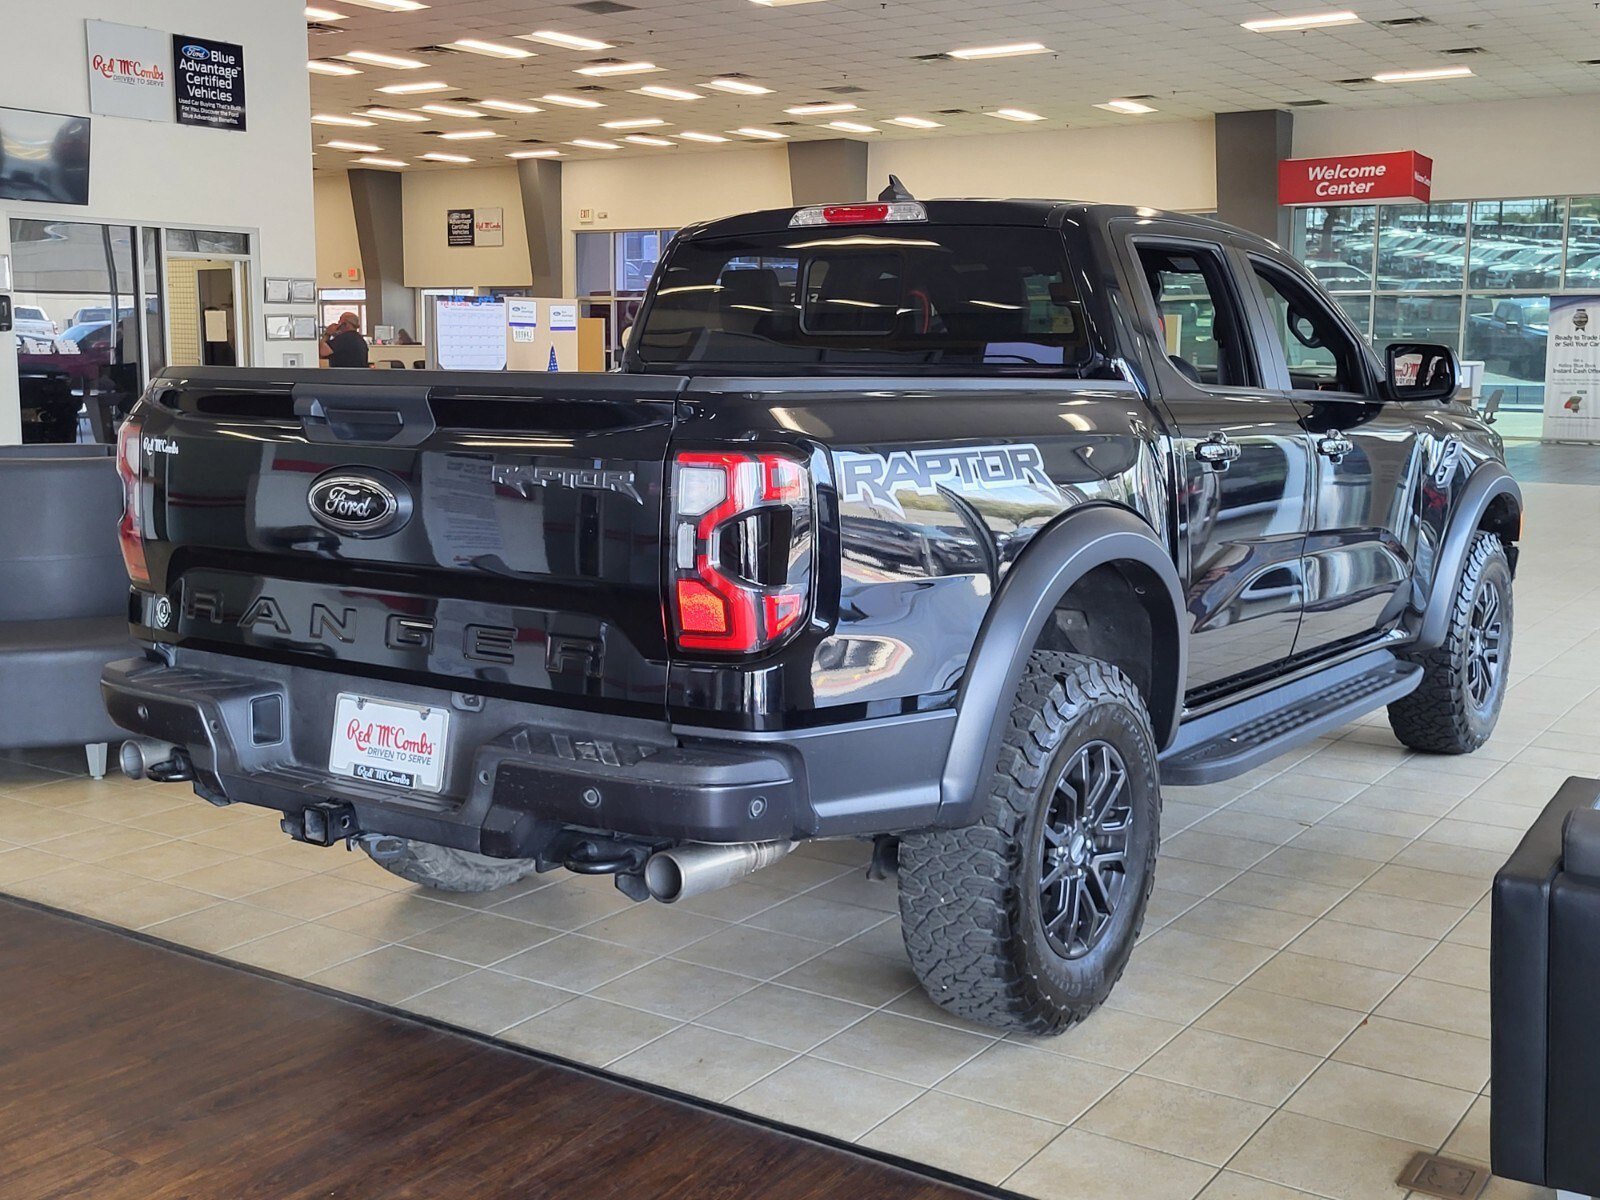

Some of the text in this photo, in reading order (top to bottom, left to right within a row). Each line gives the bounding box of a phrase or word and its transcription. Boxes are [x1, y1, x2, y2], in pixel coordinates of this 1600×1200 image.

[211, 50, 235, 65] Blue
[93, 55, 164, 80] Red McCombs
[113, 74, 165, 87] DRIVEN TO SERVE
[186, 72, 232, 89] Certified
[187, 85, 232, 102] Vehicles
[1308, 164, 1386, 180] Welcome
[1316, 181, 1374, 196] Center
[580, 209, 590, 218] EXIT
[1554, 334, 1573, 342] Ready
[143, 436, 154, 456] Red
[491, 463, 644, 506] RAPTOR
[840, 443, 1062, 519] RAPTOR
[324, 486, 372, 518] Ford
[184, 590, 605, 678] RANGER
[347, 718, 432, 755] Red McCombs
[367, 746, 432, 766] DRIVEN TO SERVE
[357, 766, 410, 785] Red McCombs
